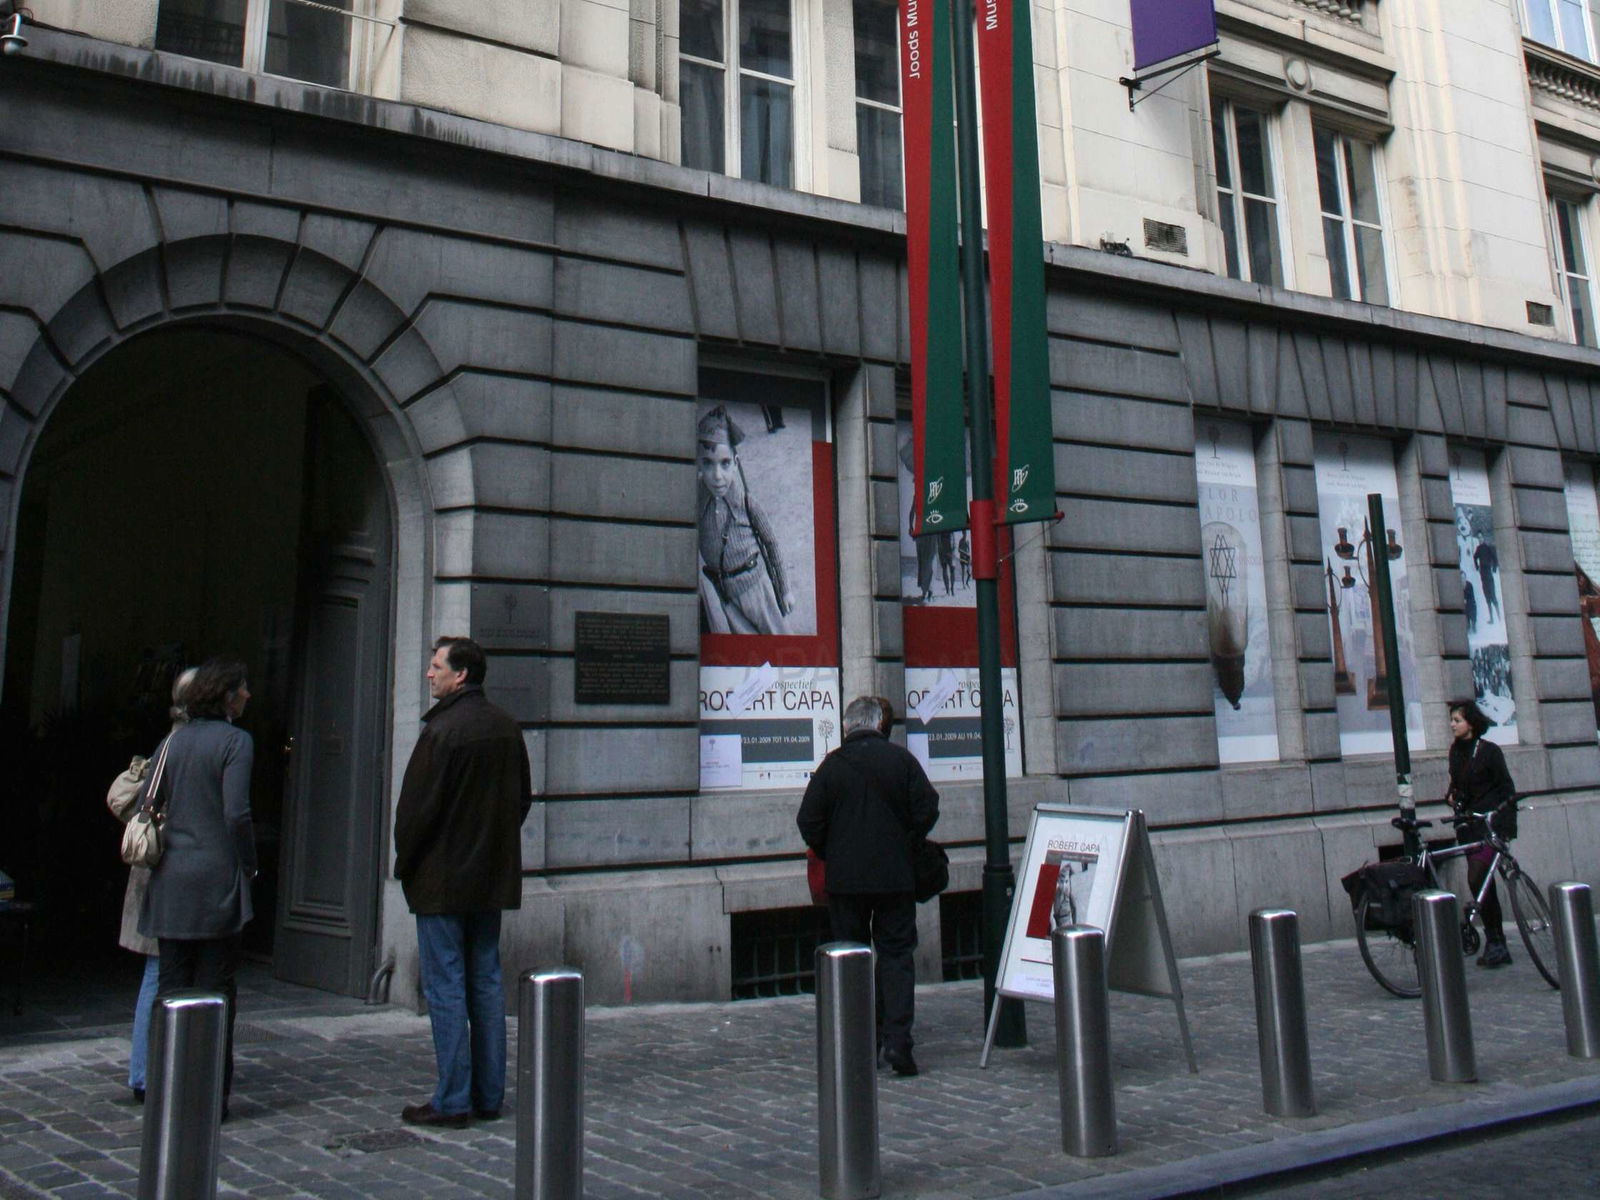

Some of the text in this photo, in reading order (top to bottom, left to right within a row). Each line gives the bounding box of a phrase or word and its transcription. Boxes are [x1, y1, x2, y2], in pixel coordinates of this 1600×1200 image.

[907, 29, 920, 79] Joods
[783, 690, 834, 711] CAPA
[1047, 839, 1100, 853] ROBERT CAPA
